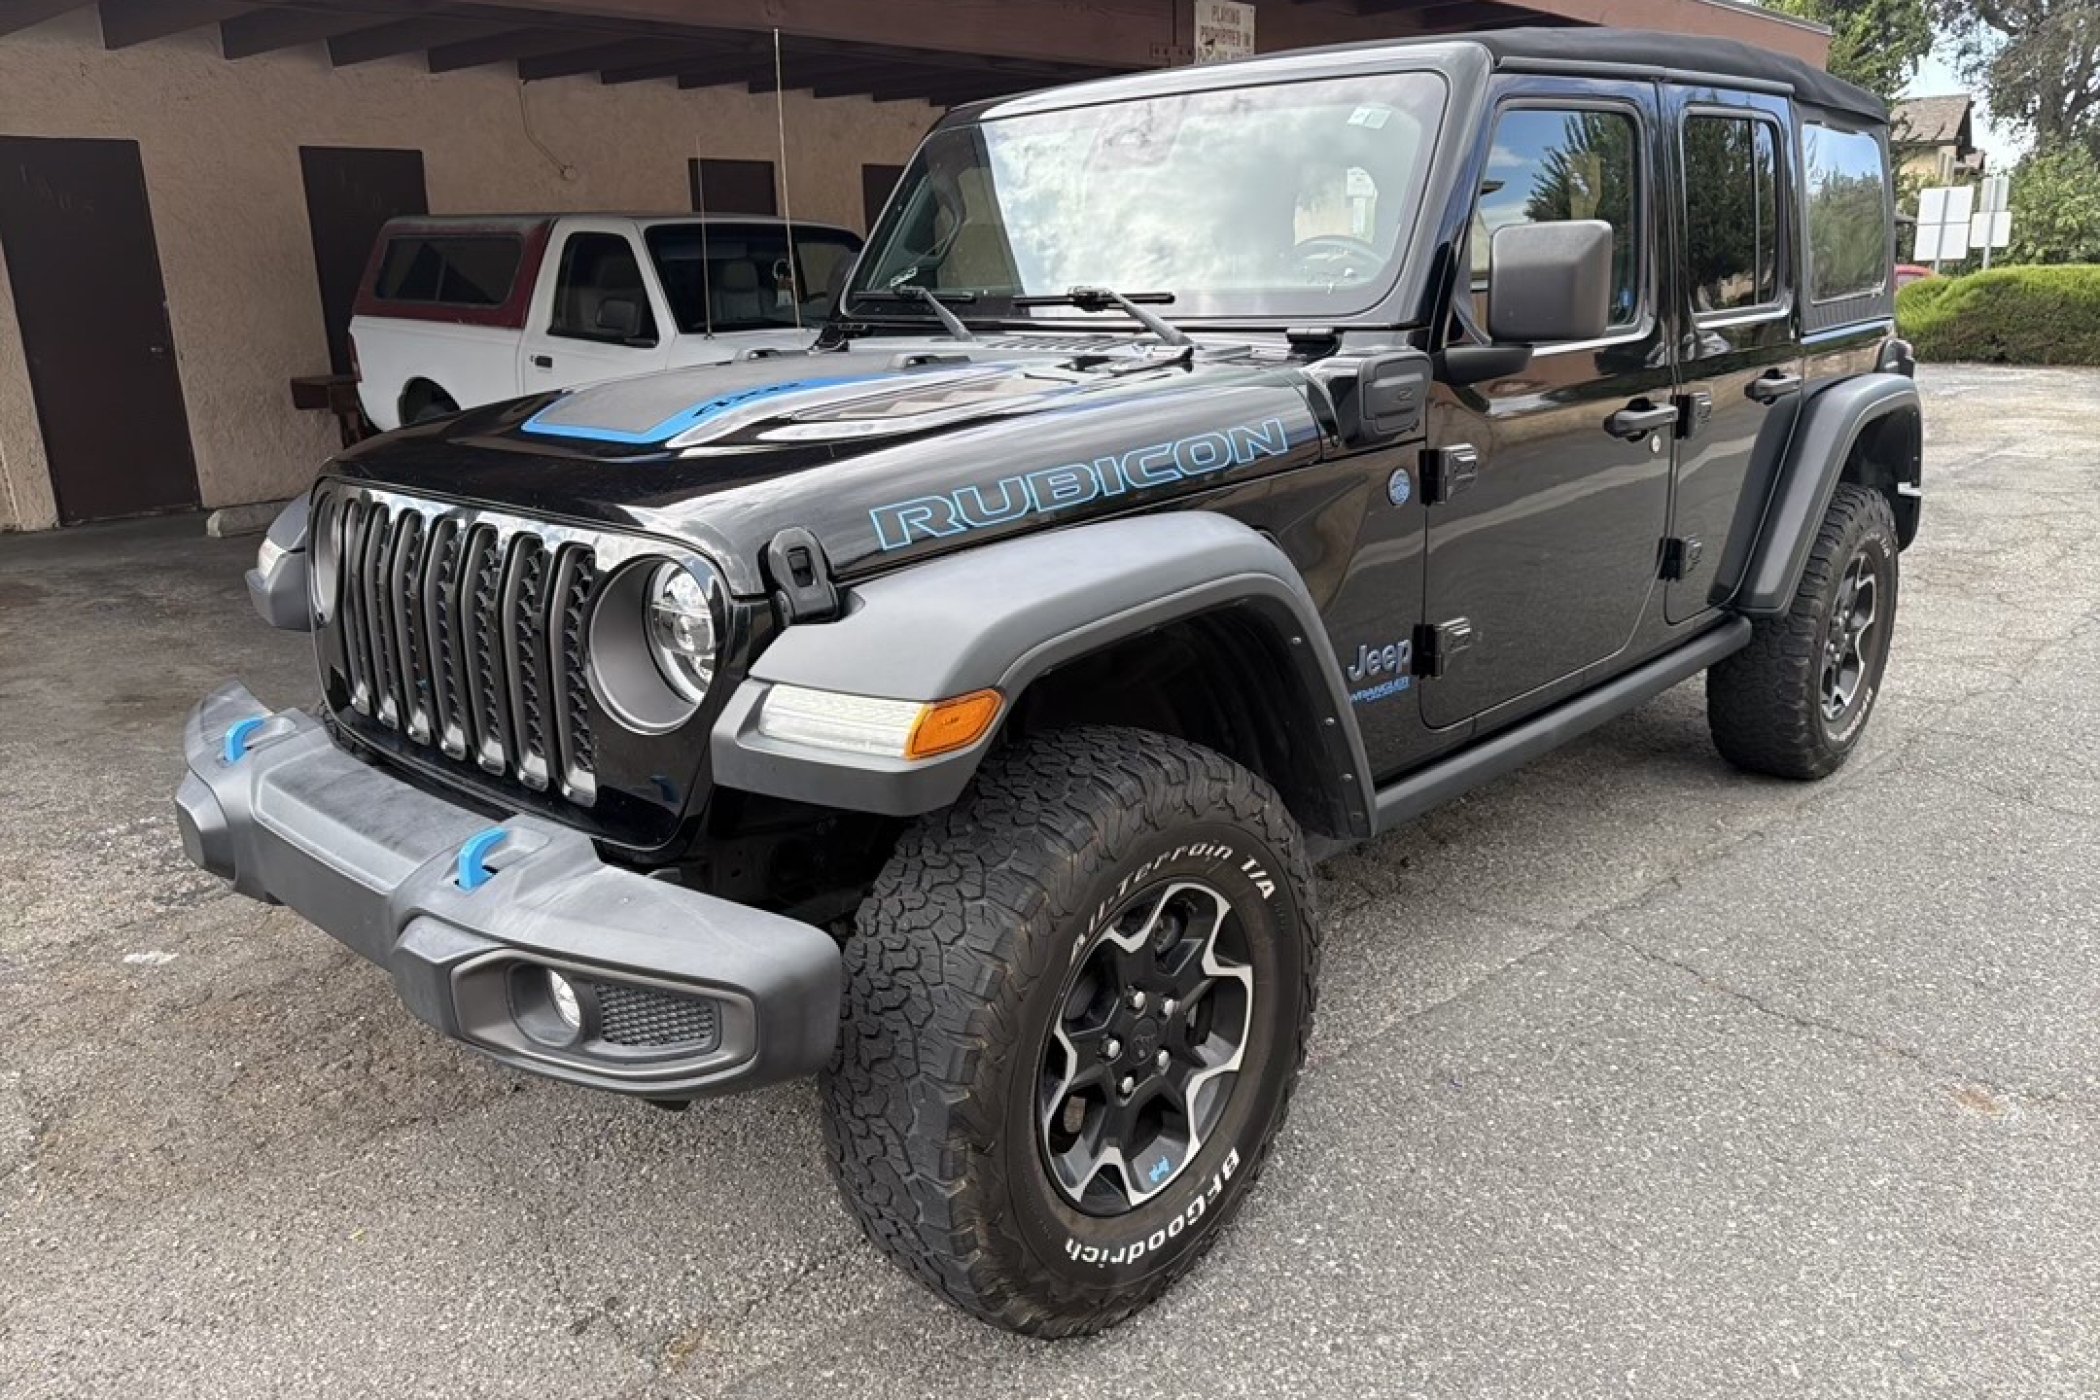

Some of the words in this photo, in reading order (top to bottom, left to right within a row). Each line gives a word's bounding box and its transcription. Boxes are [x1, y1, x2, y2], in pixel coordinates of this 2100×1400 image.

[869, 417, 1289, 551] RUBICON
[1346, 639, 1412, 682] Jeep
[1069, 840, 1234, 966] All-Terrain
[1240, 855, 1276, 899] T/A
[1065, 1147, 1240, 1268] BFGoodrich
